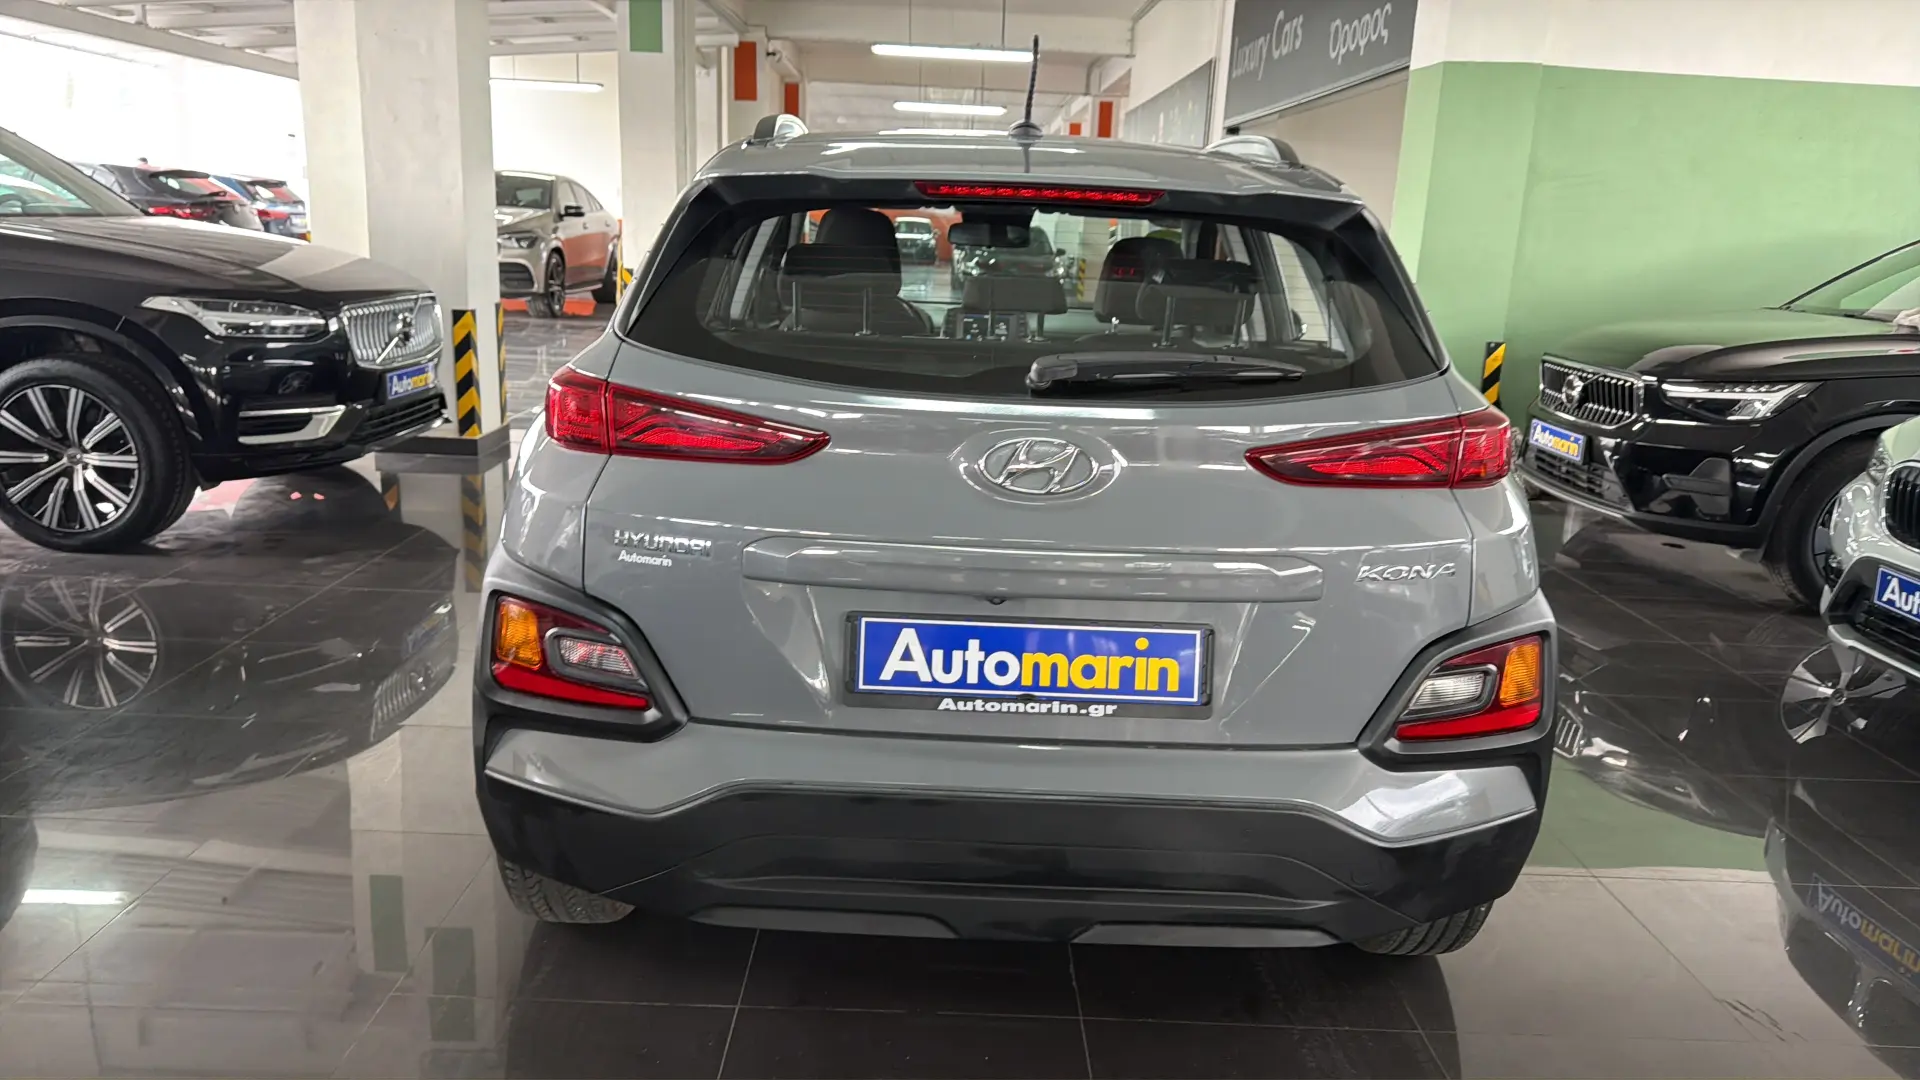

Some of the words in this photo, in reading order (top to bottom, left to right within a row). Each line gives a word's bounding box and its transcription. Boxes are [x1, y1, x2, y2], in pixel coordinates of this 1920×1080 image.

[1232, 33, 1270, 81] Luxury
[1272, 9, 1304, 60] Cars
[1533, 424, 1579, 457] Automarin
[614, 529, 712, 557] HYUNDAI
[618, 550, 672, 567] Automarin
[1355, 562, 1456, 582] KONA
[879, 627, 1180, 692] Automarin
[937, 698, 1118, 717] Automarin.gr
